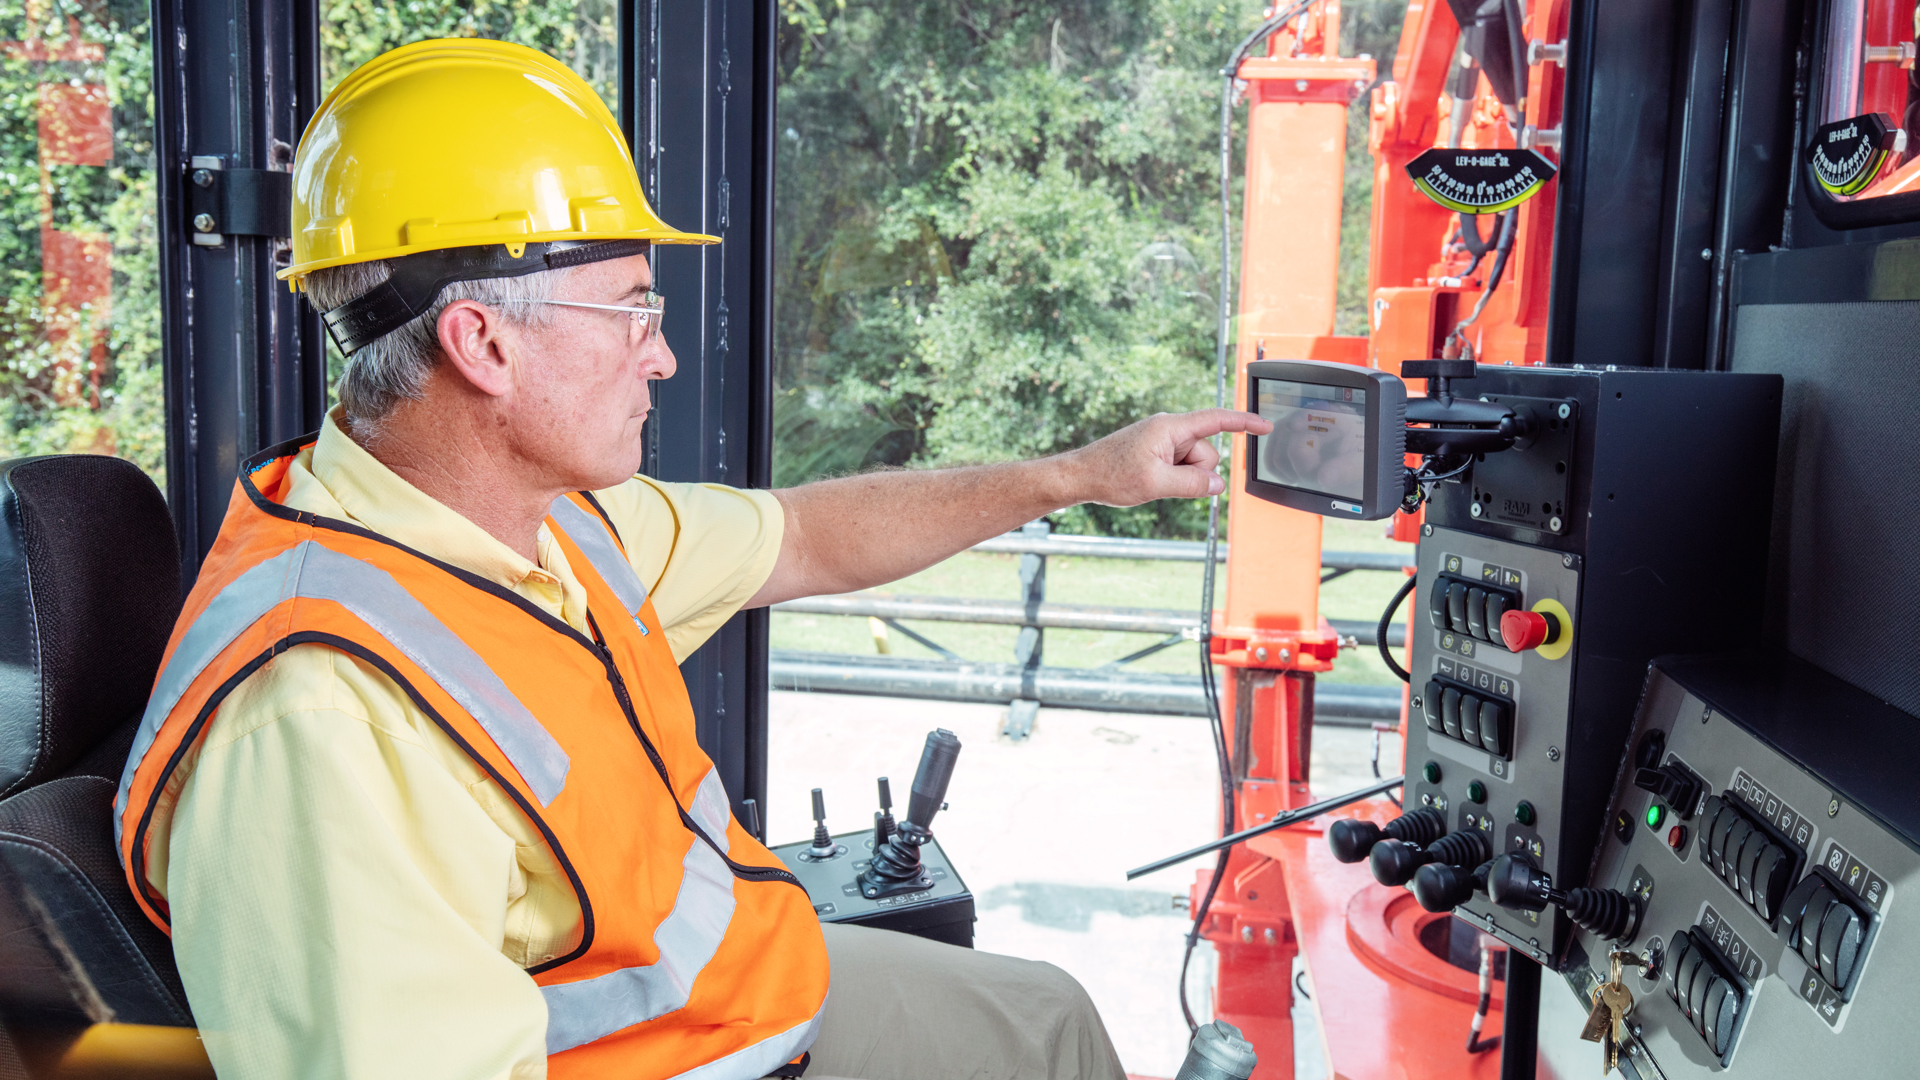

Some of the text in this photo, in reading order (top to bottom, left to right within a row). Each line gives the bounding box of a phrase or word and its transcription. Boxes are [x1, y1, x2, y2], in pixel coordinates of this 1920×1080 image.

[1431, 165, 1442, 175] 50
[1439, 173, 1449, 182] 40
[1446, 178, 1457, 188] 30
[1455, 182, 1465, 192] 20
[1466, 185, 1474, 195] 10
[1486, 186, 1494, 195] 10
[1495, 183, 1505, 193] 20
[1505, 179, 1515, 189] 30
[1514, 173, 1524, 183] 40
[1520, 166, 1532, 177] 50
[1503, 499, 1530, 516] RAM
[1540, 875, 1551, 899] LIFT
